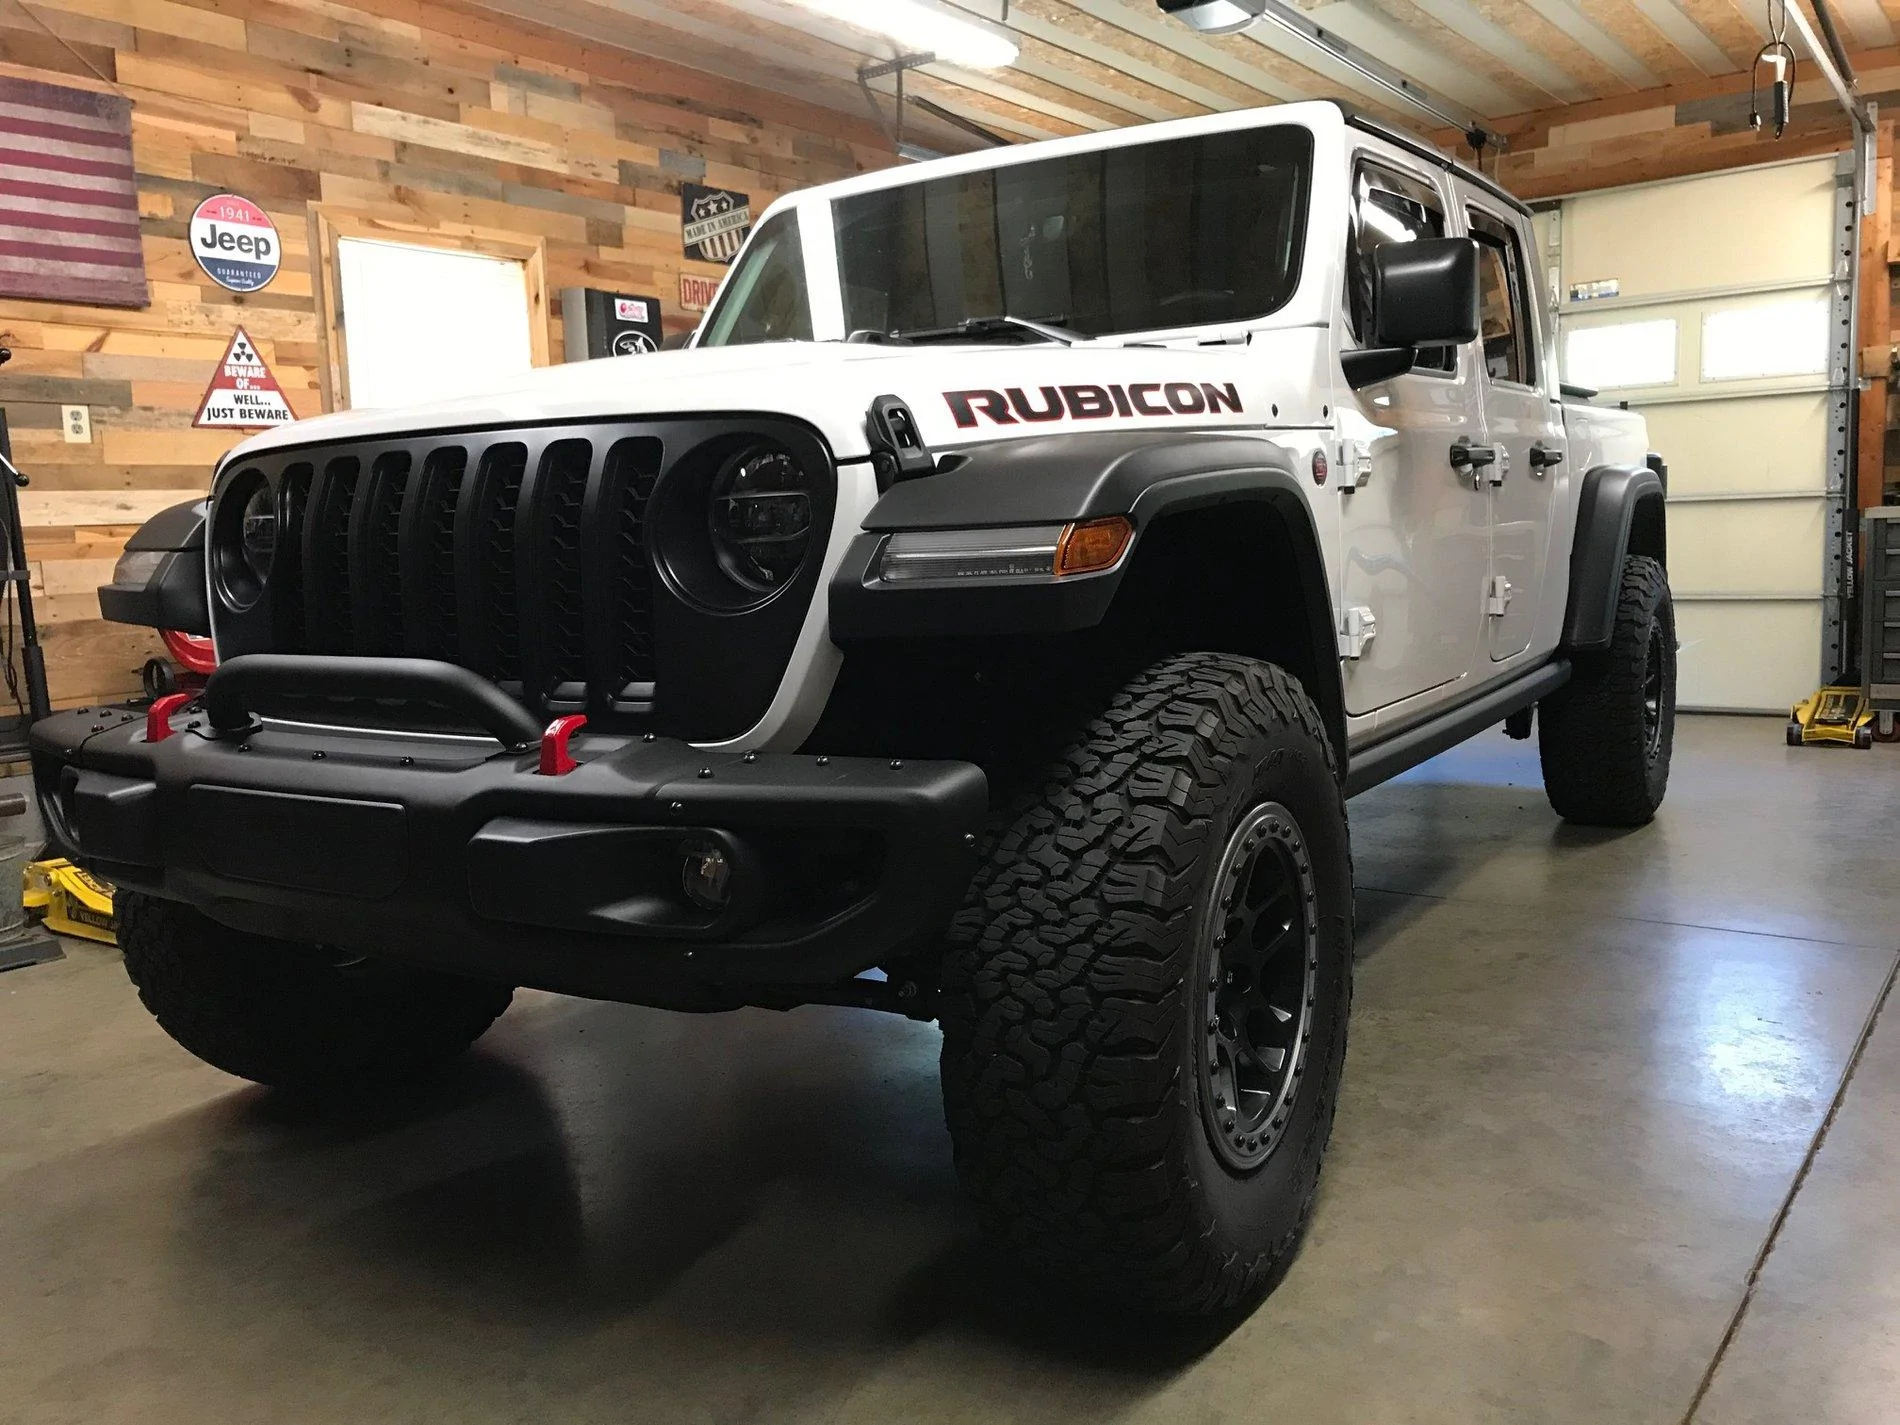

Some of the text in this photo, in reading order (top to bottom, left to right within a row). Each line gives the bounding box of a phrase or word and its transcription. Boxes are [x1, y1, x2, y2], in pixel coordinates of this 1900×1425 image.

[220, 206, 250, 222] 1941
[685, 210, 749, 239] MADE IN AMERICA
[200, 223, 271, 260] Jeep
[217, 267, 262, 279] GUARANTEED
[224, 365, 267, 378] BEWARE
[235, 378, 261, 390] OF...
[233, 393, 271, 406] WELL...
[942, 382, 1244, 429] RUBICON
[207, 407, 289, 421] JUST BEWARE
[1845, 530, 1854, 600] YELLOW JACKET
